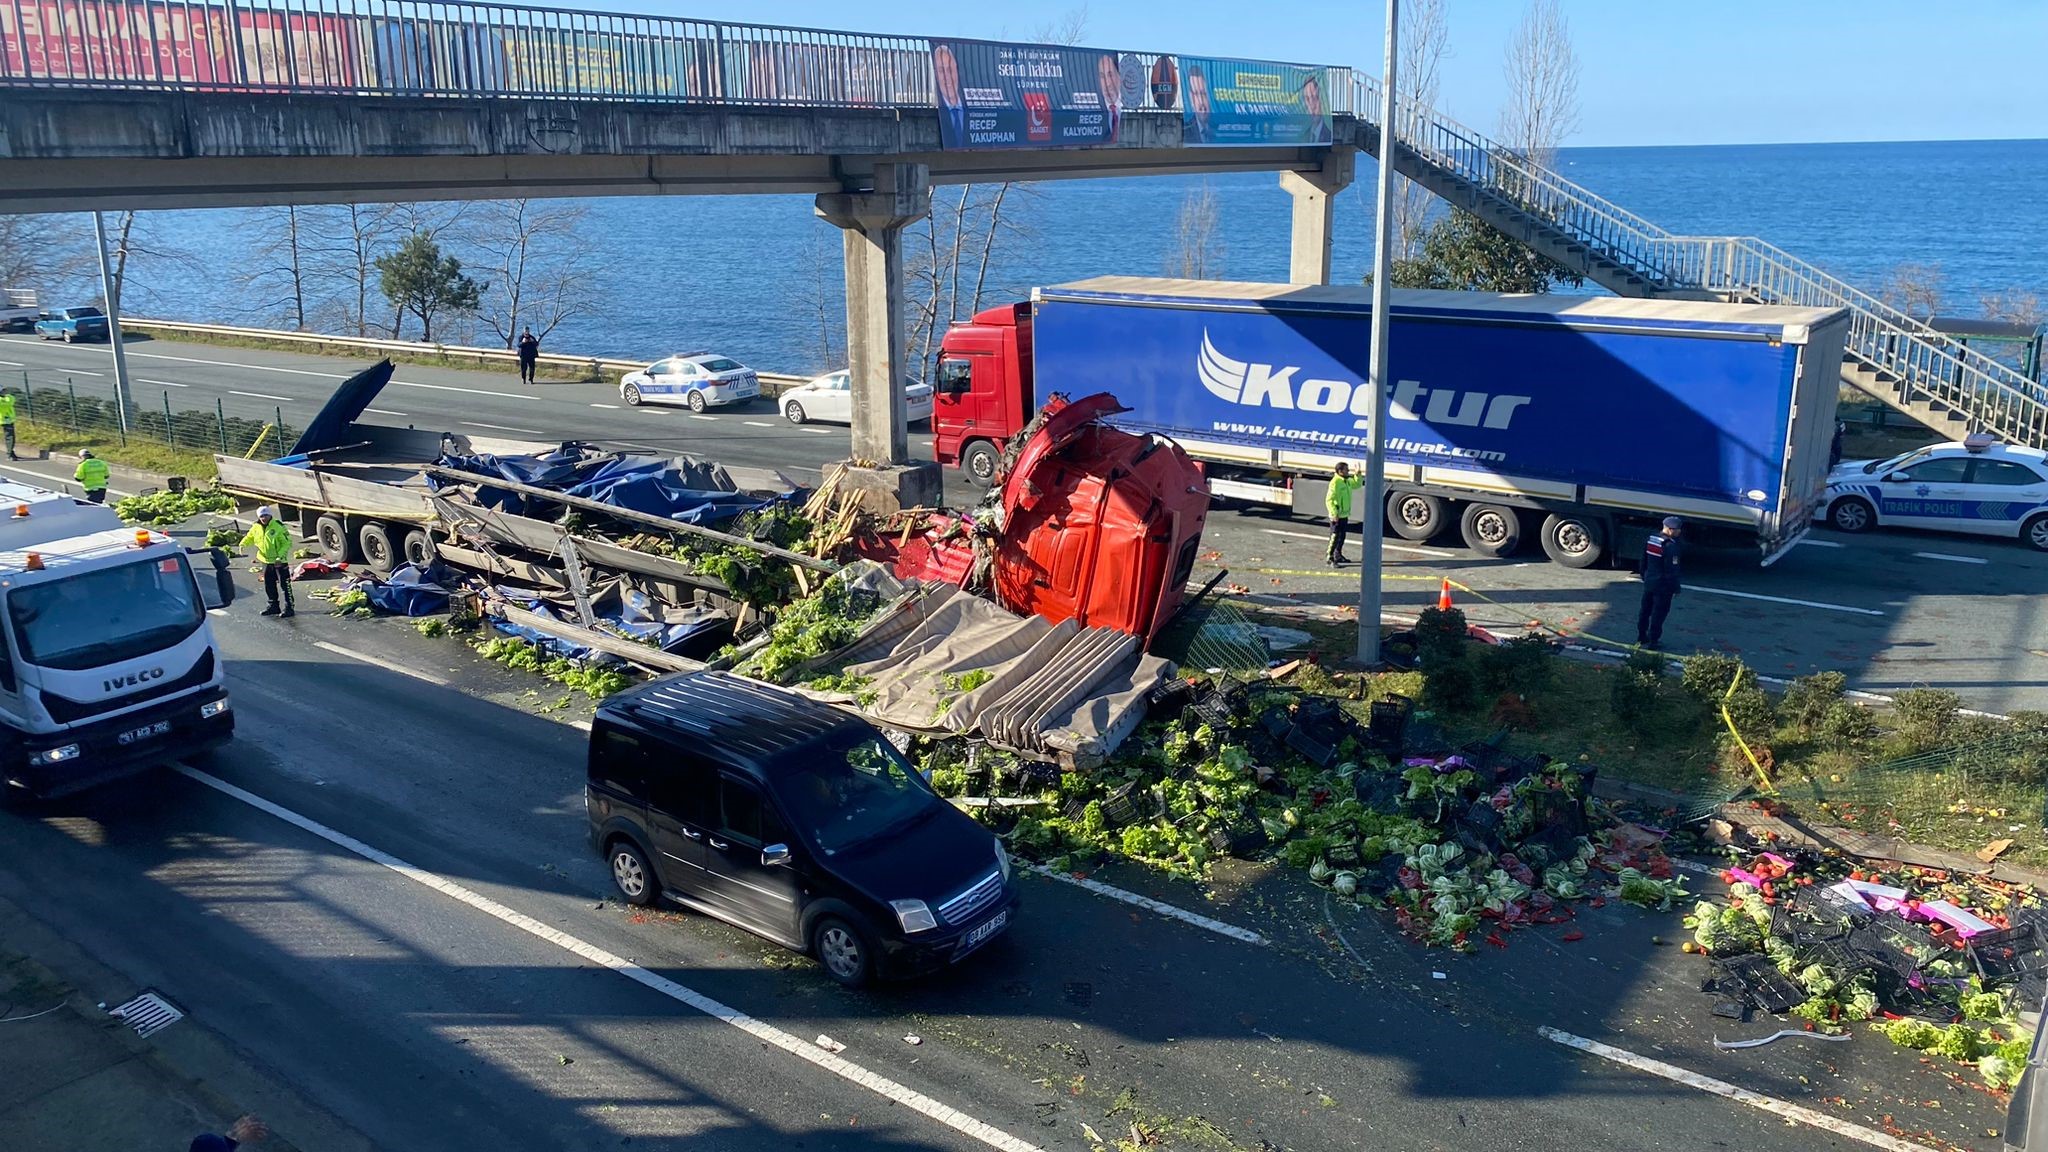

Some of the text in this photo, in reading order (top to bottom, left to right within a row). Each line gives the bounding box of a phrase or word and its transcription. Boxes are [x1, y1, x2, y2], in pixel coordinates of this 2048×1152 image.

[998, 61, 1063, 78] senin hakkın
[969, 119, 997, 130] RECEP
[1079, 114, 1103, 125] RECEP
[1030, 126, 1049, 134] SAADET
[1063, 126, 1103, 137] KALYONCU
[970, 131, 1016, 144] YAKUPHAN
[1884, 501, 1962, 516] TRAFİK POLİSİ
[103, 667, 164, 692] IVECO
